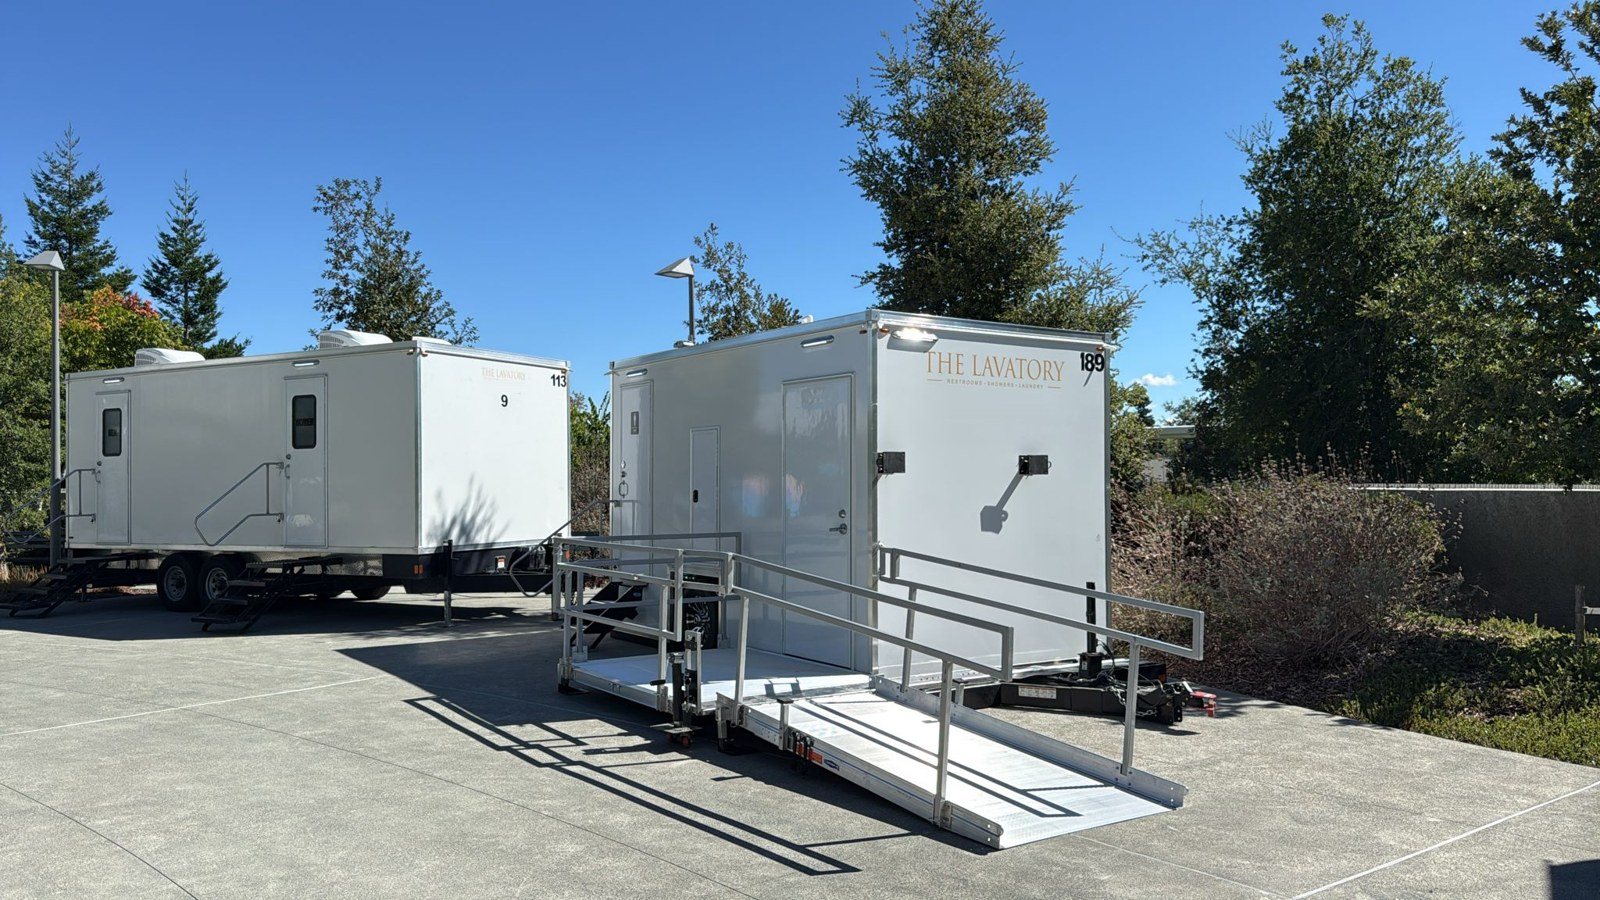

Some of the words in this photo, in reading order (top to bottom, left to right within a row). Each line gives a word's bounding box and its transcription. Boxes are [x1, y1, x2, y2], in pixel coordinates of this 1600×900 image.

[927, 351, 964, 375] THE
[972, 354, 1065, 382] LAVATORY
[1080, 352, 1105, 372] 189
[482, 367, 494, 378] THE
[550, 374, 567, 387] 113
[500, 394, 508, 408] 9
